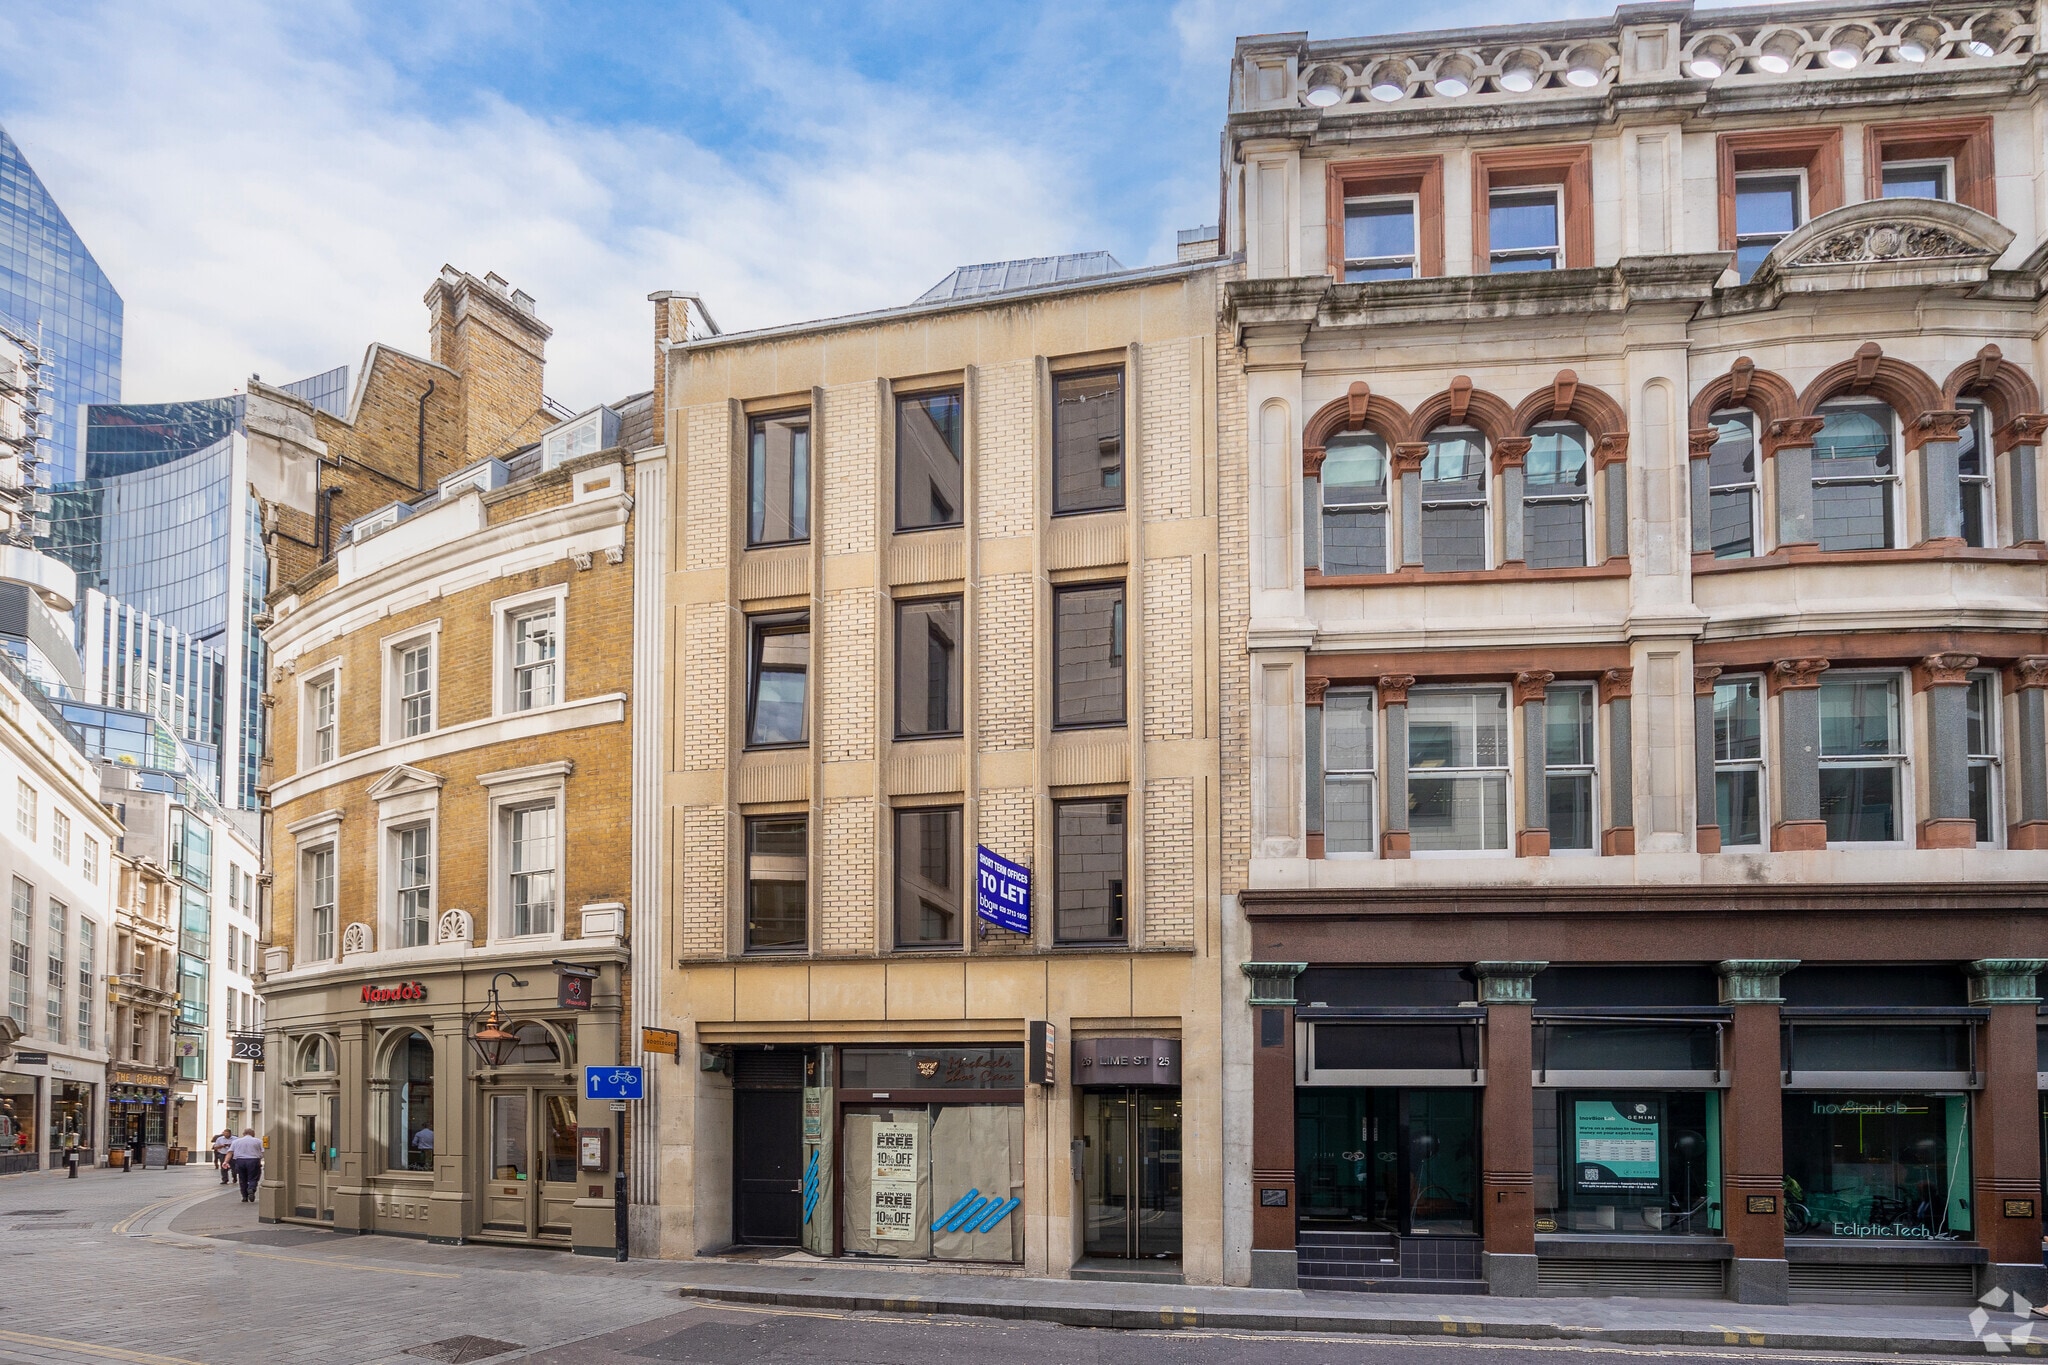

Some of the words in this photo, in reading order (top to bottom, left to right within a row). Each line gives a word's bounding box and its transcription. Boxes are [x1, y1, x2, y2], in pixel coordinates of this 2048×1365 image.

[980, 853, 994, 868] SHORT
[994, 862, 1007, 876] TERM
[1007, 868, 1028, 884] OFFICES
[980, 869, 997, 893] TO
[1000, 880, 1026, 905] LET
[360, 980, 422, 1003] Nando's
[235, 1042, 261, 1058] 28
[1100, 1056, 1128, 1065] LIME
[1133, 1056, 1150, 1065] ST
[1158, 1057, 1170, 1066] 25
[115, 1072, 130, 1082] THE
[136, 1073, 167, 1085] GRAPES
[877, 1137, 913, 1146] FREE
[877, 1152, 894, 1163] 10%
[896, 1153, 912, 1164] OFF
[876, 1196, 912, 1205] FREE
[876, 1211, 893, 1223] 10%
[895, 1212, 911, 1223] OFF
[1834, 1222, 1930, 1237] Ecliptic.Tech
